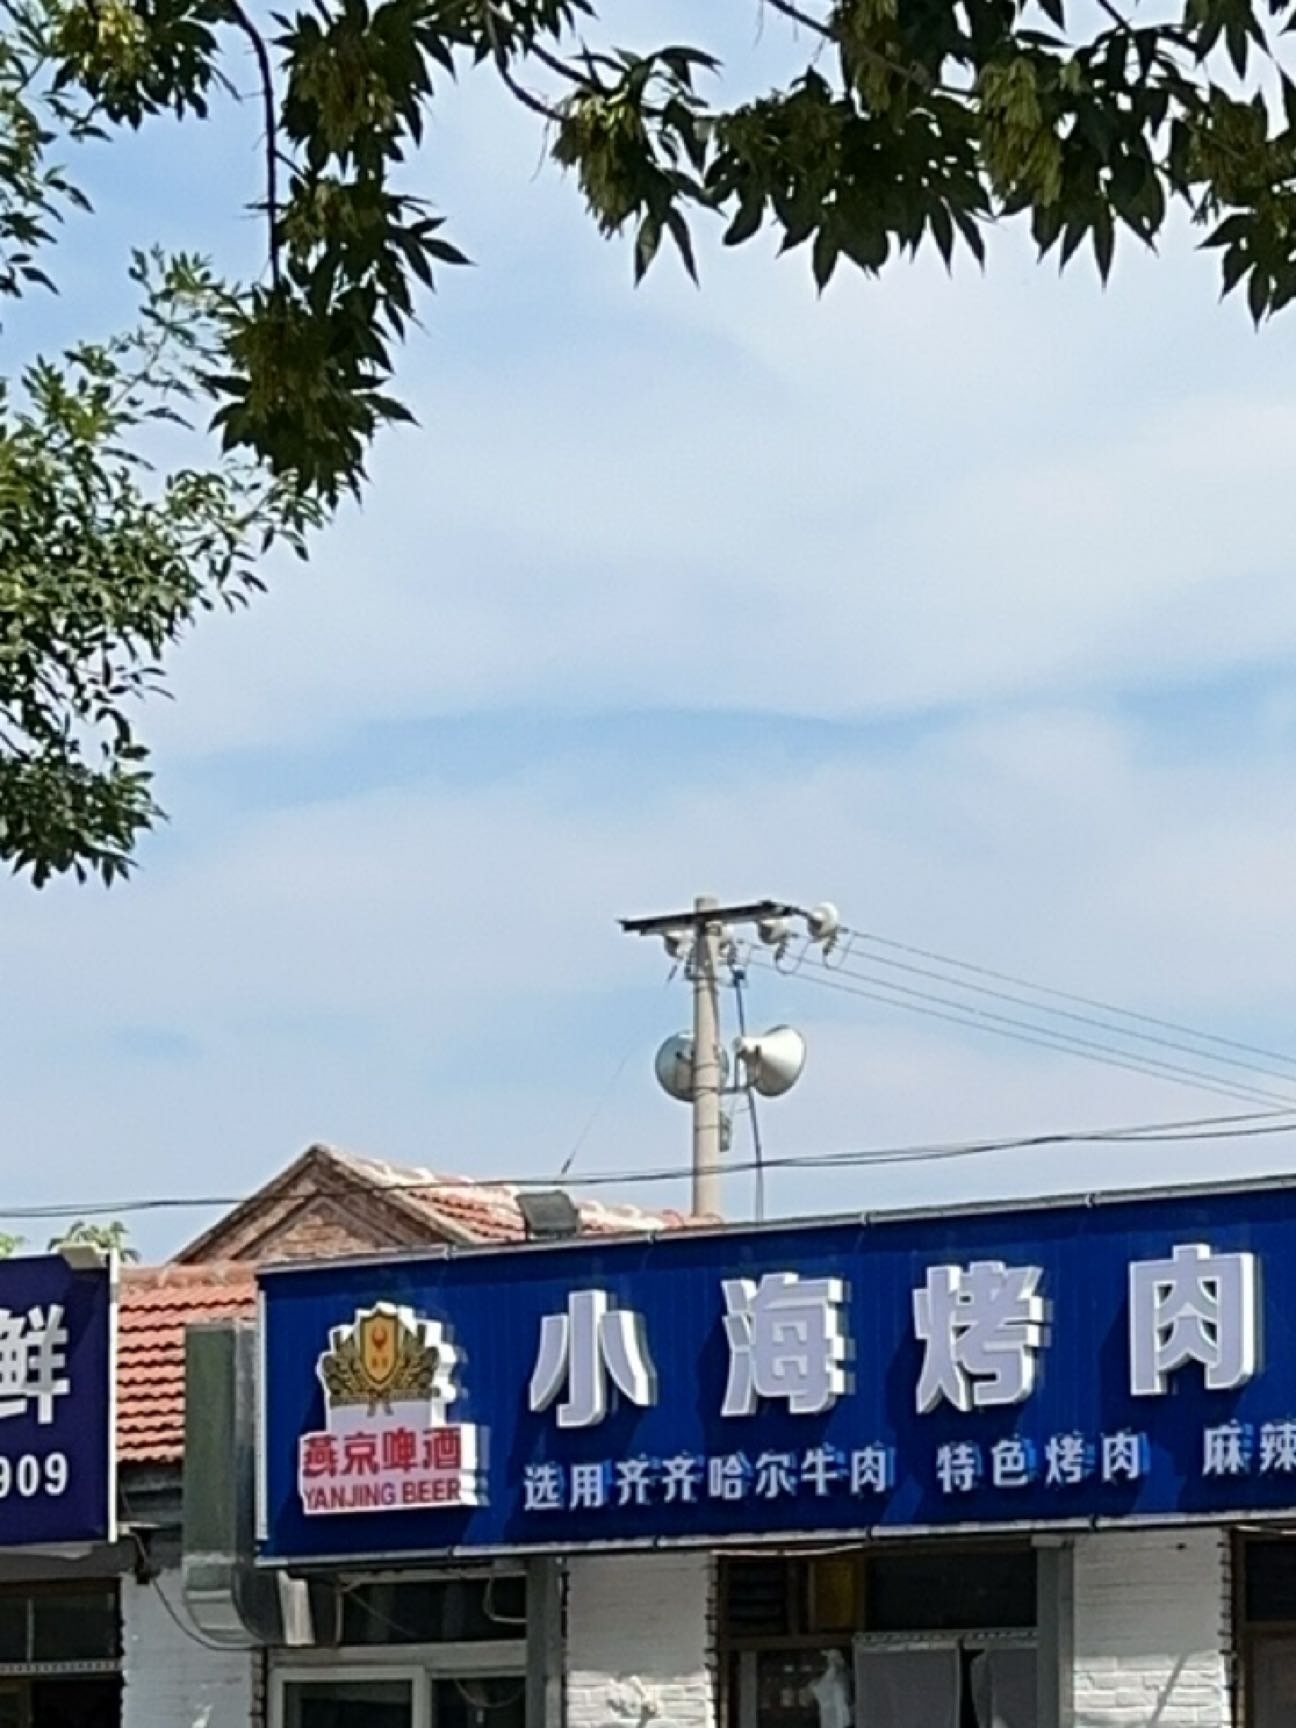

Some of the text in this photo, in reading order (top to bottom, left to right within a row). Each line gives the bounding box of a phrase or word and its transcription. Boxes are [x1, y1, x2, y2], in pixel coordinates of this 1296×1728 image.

[302, 1427, 461, 1478] 燕京啤酒
[523, 1446, 888, 1511] 选用齐齐哈尔牛肉
[936, 1432, 1142, 1493] 特色烤肉
[303, 1478, 461, 1511] YANJING BEER
